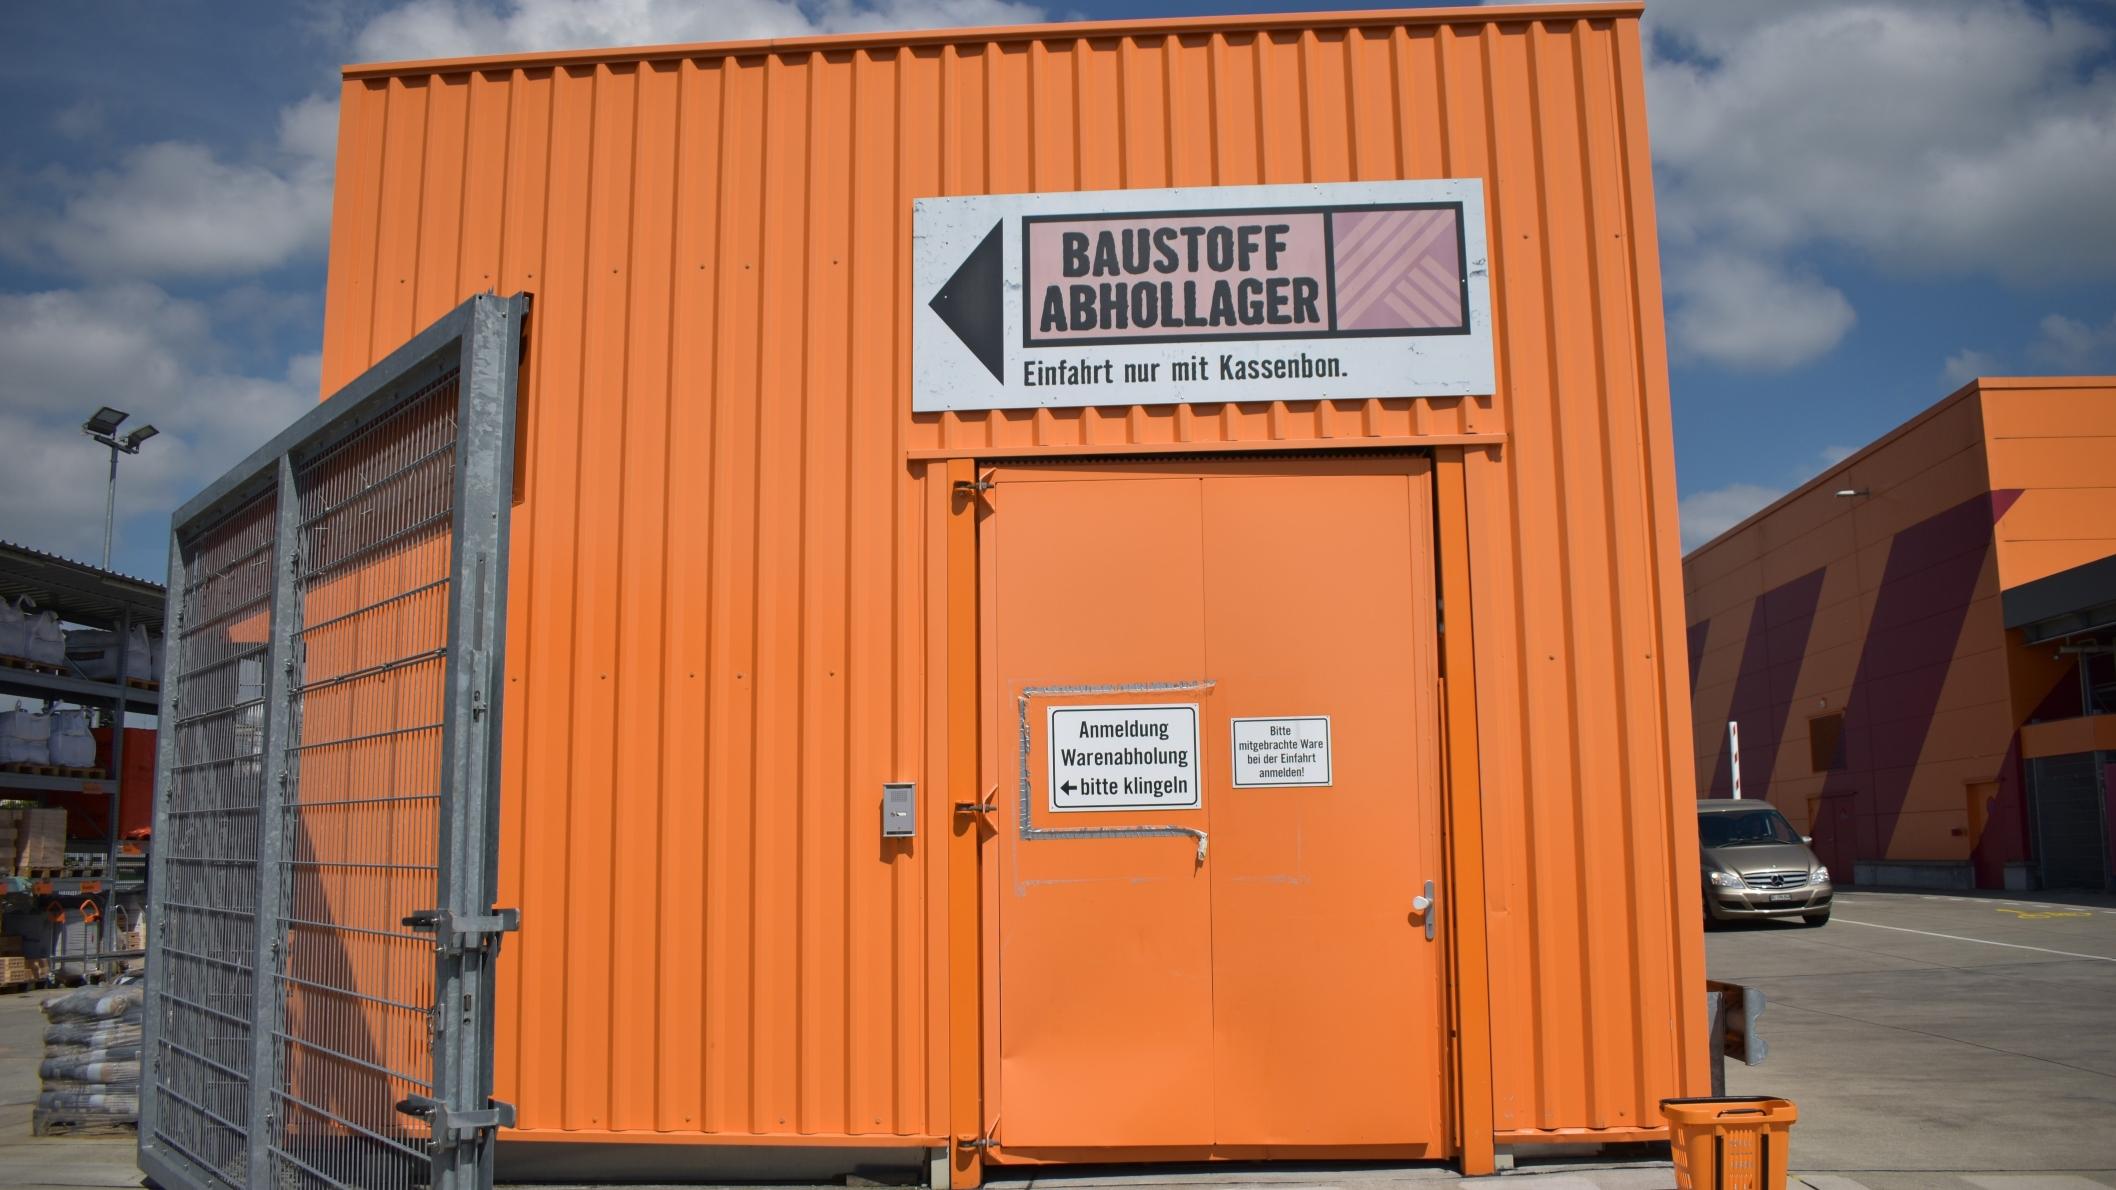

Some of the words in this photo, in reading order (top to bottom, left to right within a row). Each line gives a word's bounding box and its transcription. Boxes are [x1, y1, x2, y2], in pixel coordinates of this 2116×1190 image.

[1062, 224, 1291, 278] BAUSTOFF
[1039, 276, 1320, 333] ABHOLLAGER
[1023, 359, 1114, 386] Einfahrt
[1124, 362, 1160, 383] nur
[1172, 355, 1208, 381] mit
[1219, 353, 1348, 380] Kassenbon.
[1079, 720, 1169, 741] Anmeldung
[1270, 725, 1291, 736] Bitte
[1239, 739, 1298, 752] mitgebrachte
[1300, 739, 1324, 749] Ware
[1061, 747, 1188, 767] Warenabholung
[1247, 754, 1260, 764] bei
[1263, 753, 1278, 764] der
[1280, 752, 1316, 763] Einfahrt
[1259, 767, 1305, 778] anmelden!
[1080, 777, 1118, 795] bitte
[1124, 776, 1188, 798] klingeln
